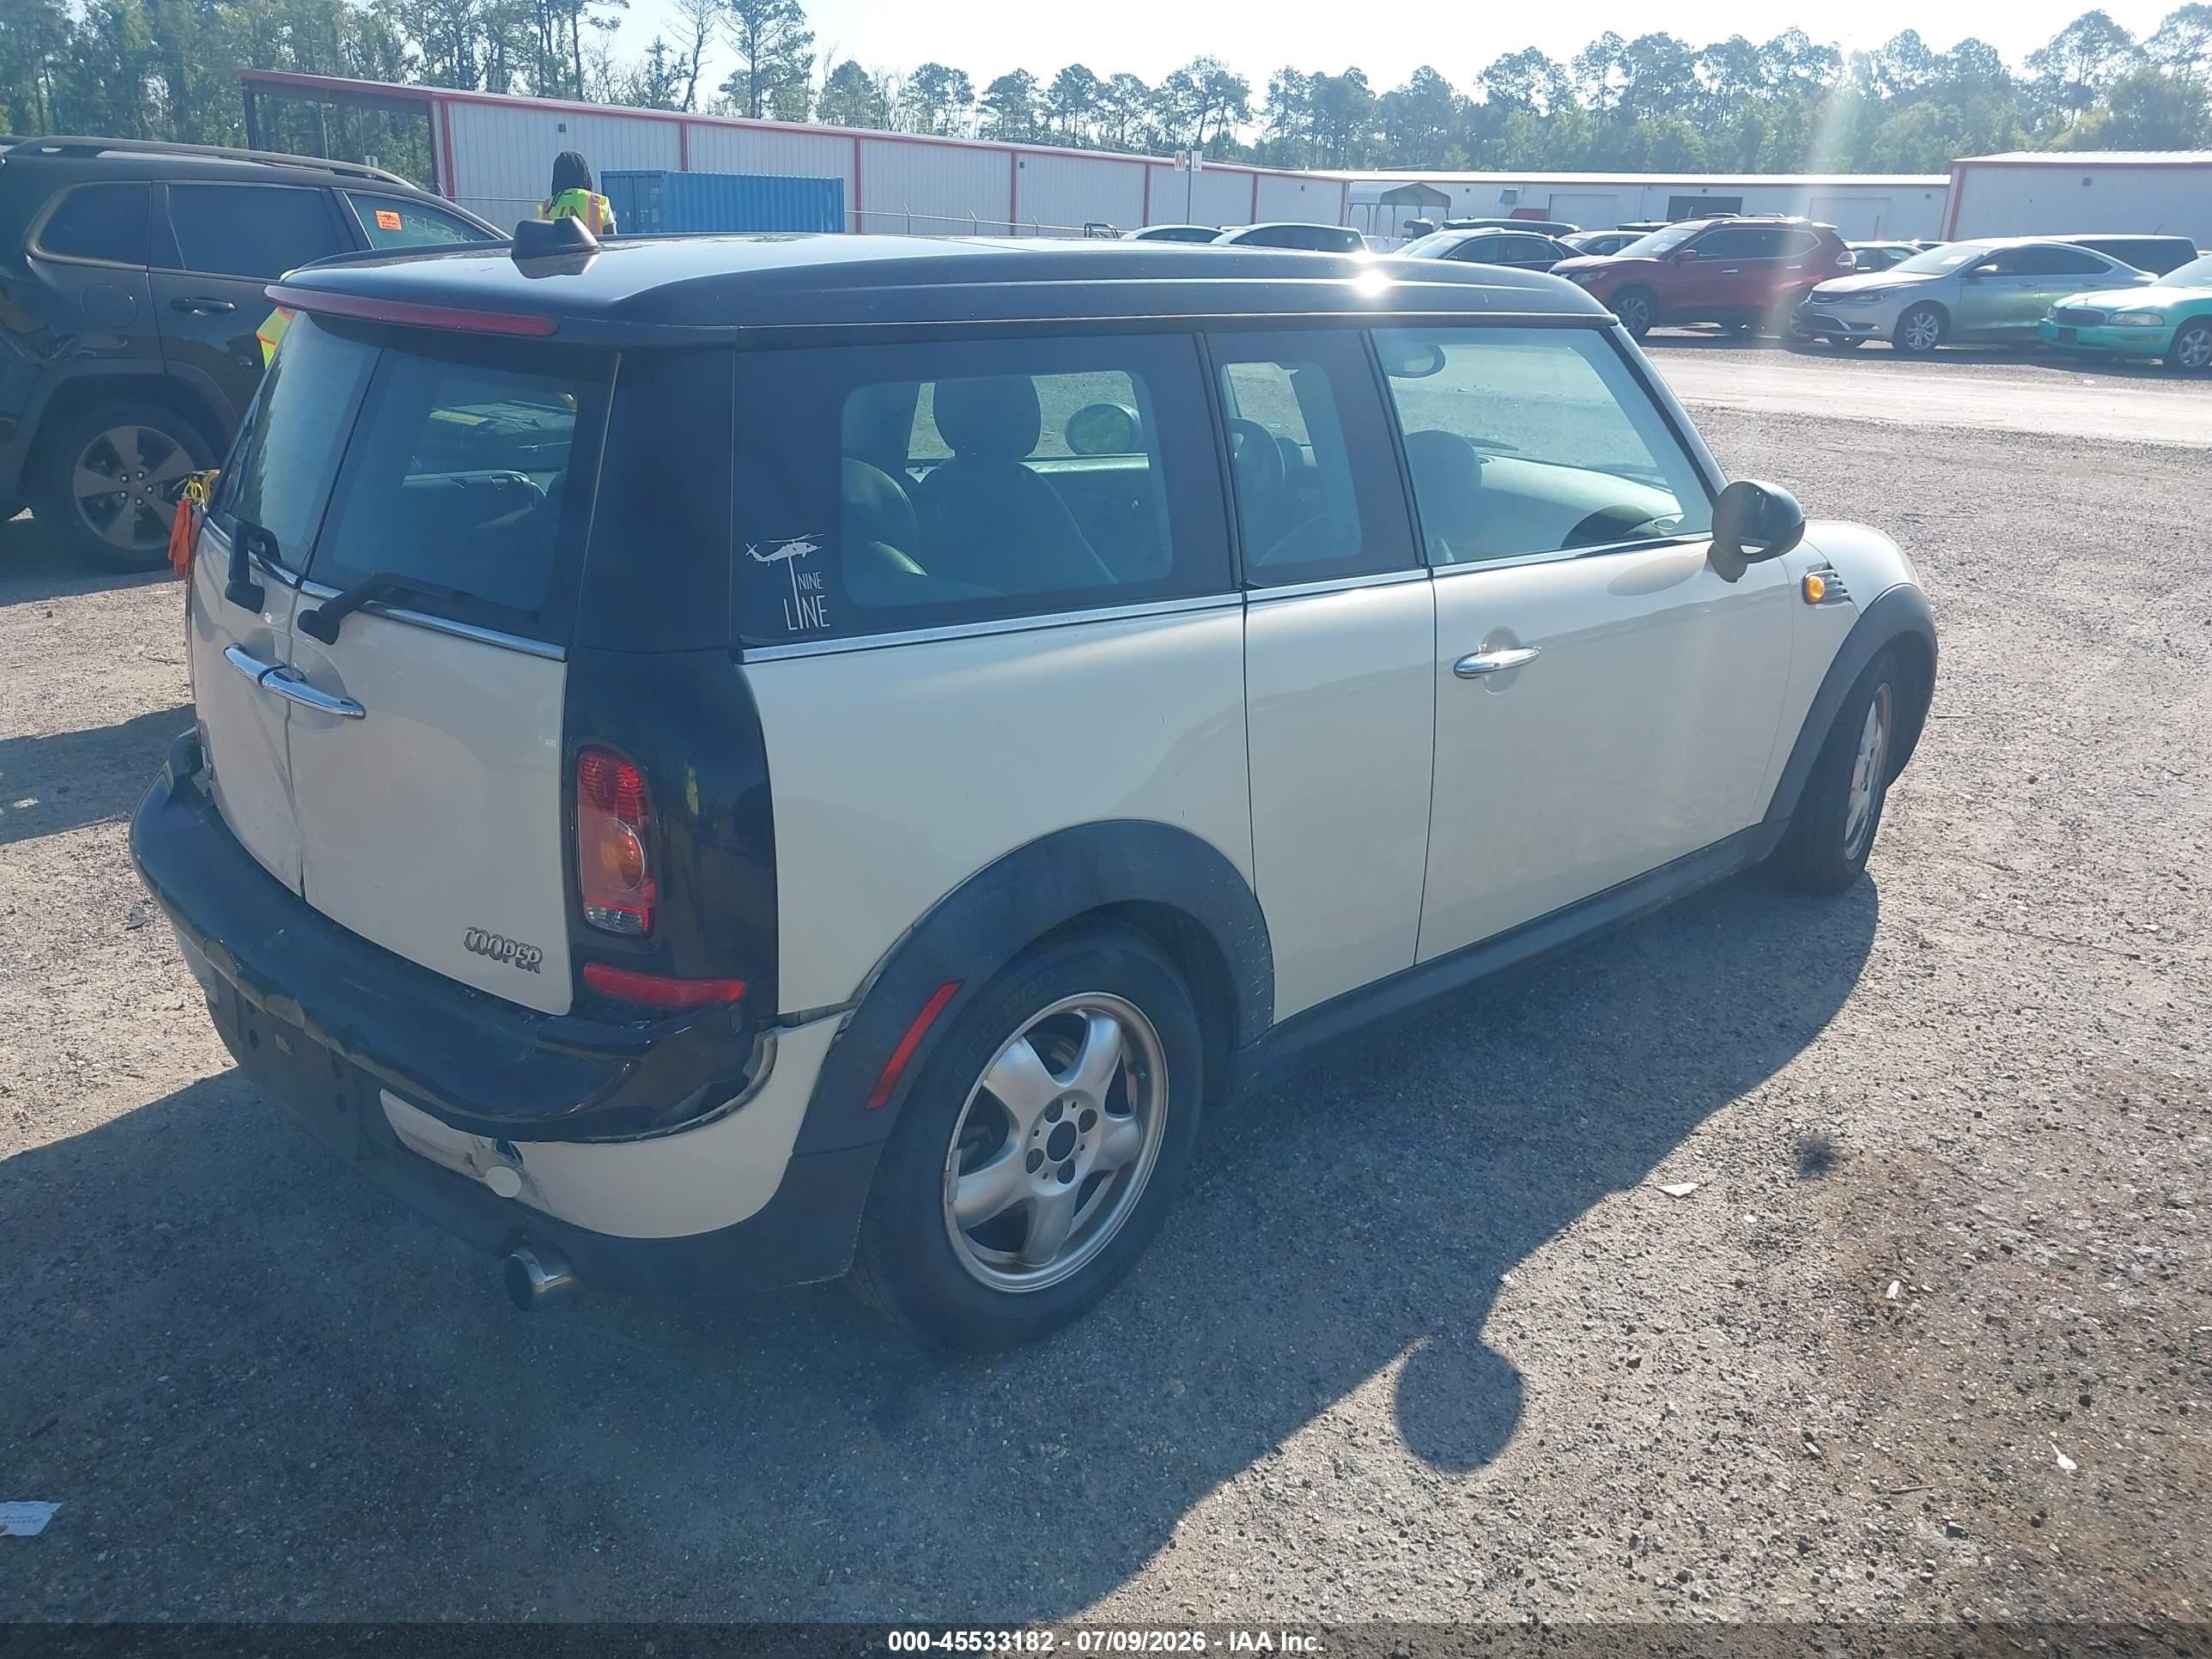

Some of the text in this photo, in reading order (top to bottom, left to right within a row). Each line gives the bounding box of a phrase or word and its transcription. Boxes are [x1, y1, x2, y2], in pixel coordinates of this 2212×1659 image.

[1176, 153, 1185, 169] M
[797, 571, 824, 592] NINE
[782, 594, 831, 631] LINE
[464, 927, 543, 975] COOPER
